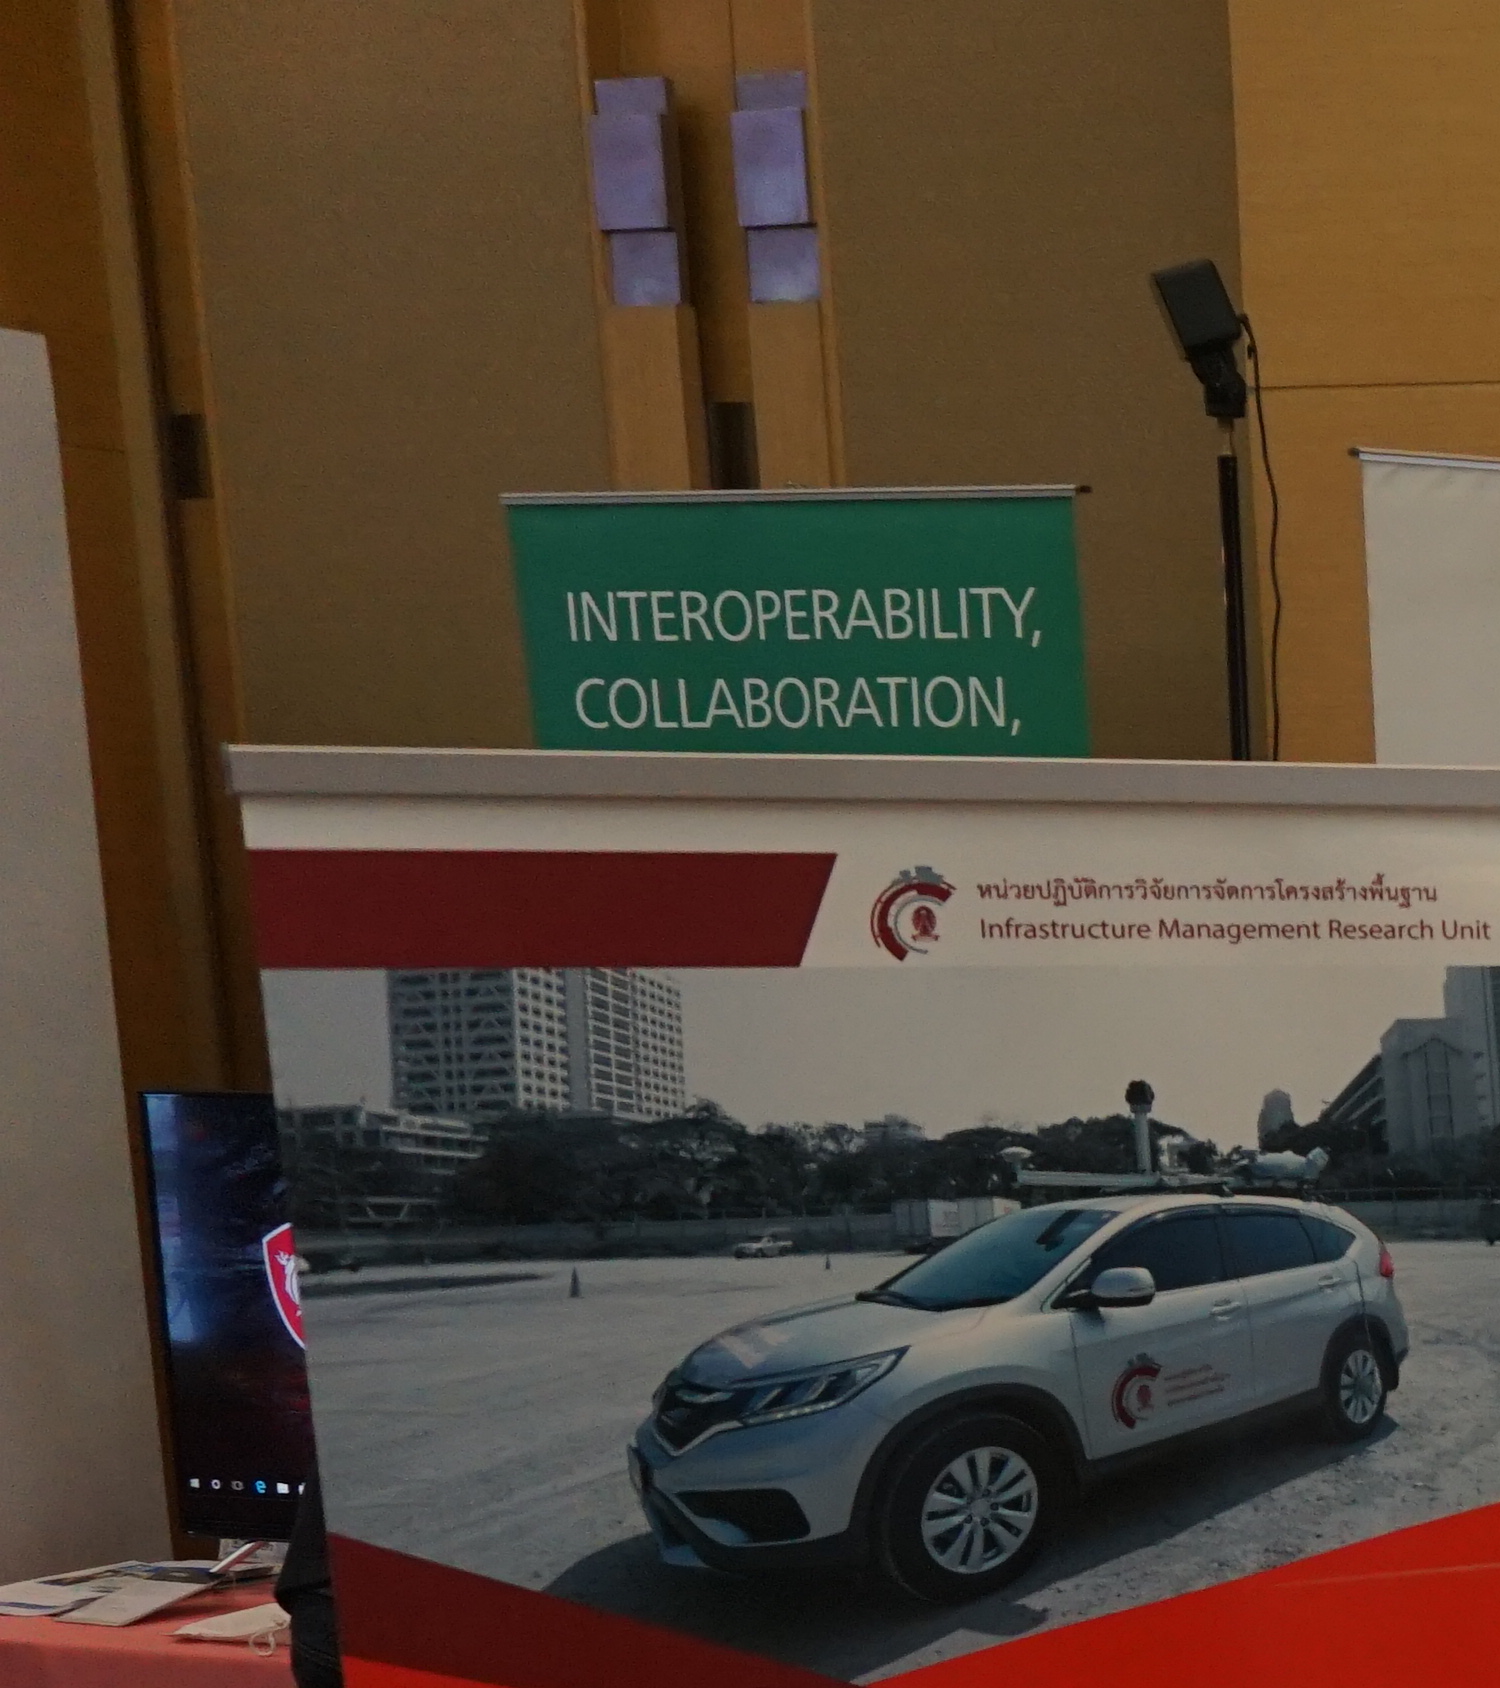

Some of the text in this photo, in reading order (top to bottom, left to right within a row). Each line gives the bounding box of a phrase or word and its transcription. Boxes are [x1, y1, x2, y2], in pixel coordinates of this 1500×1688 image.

[566, 586, 1043, 648] INTEROPERABILITY,
[575, 675, 1022, 736] COLLABORATION,
[976, 872, 1437, 908] หน่วยปฏิบัติการวิจัยการจัดการโครงสร้างพื้นฐาน
[979, 918, 1492, 945] Infrastructure Management Research Unit
